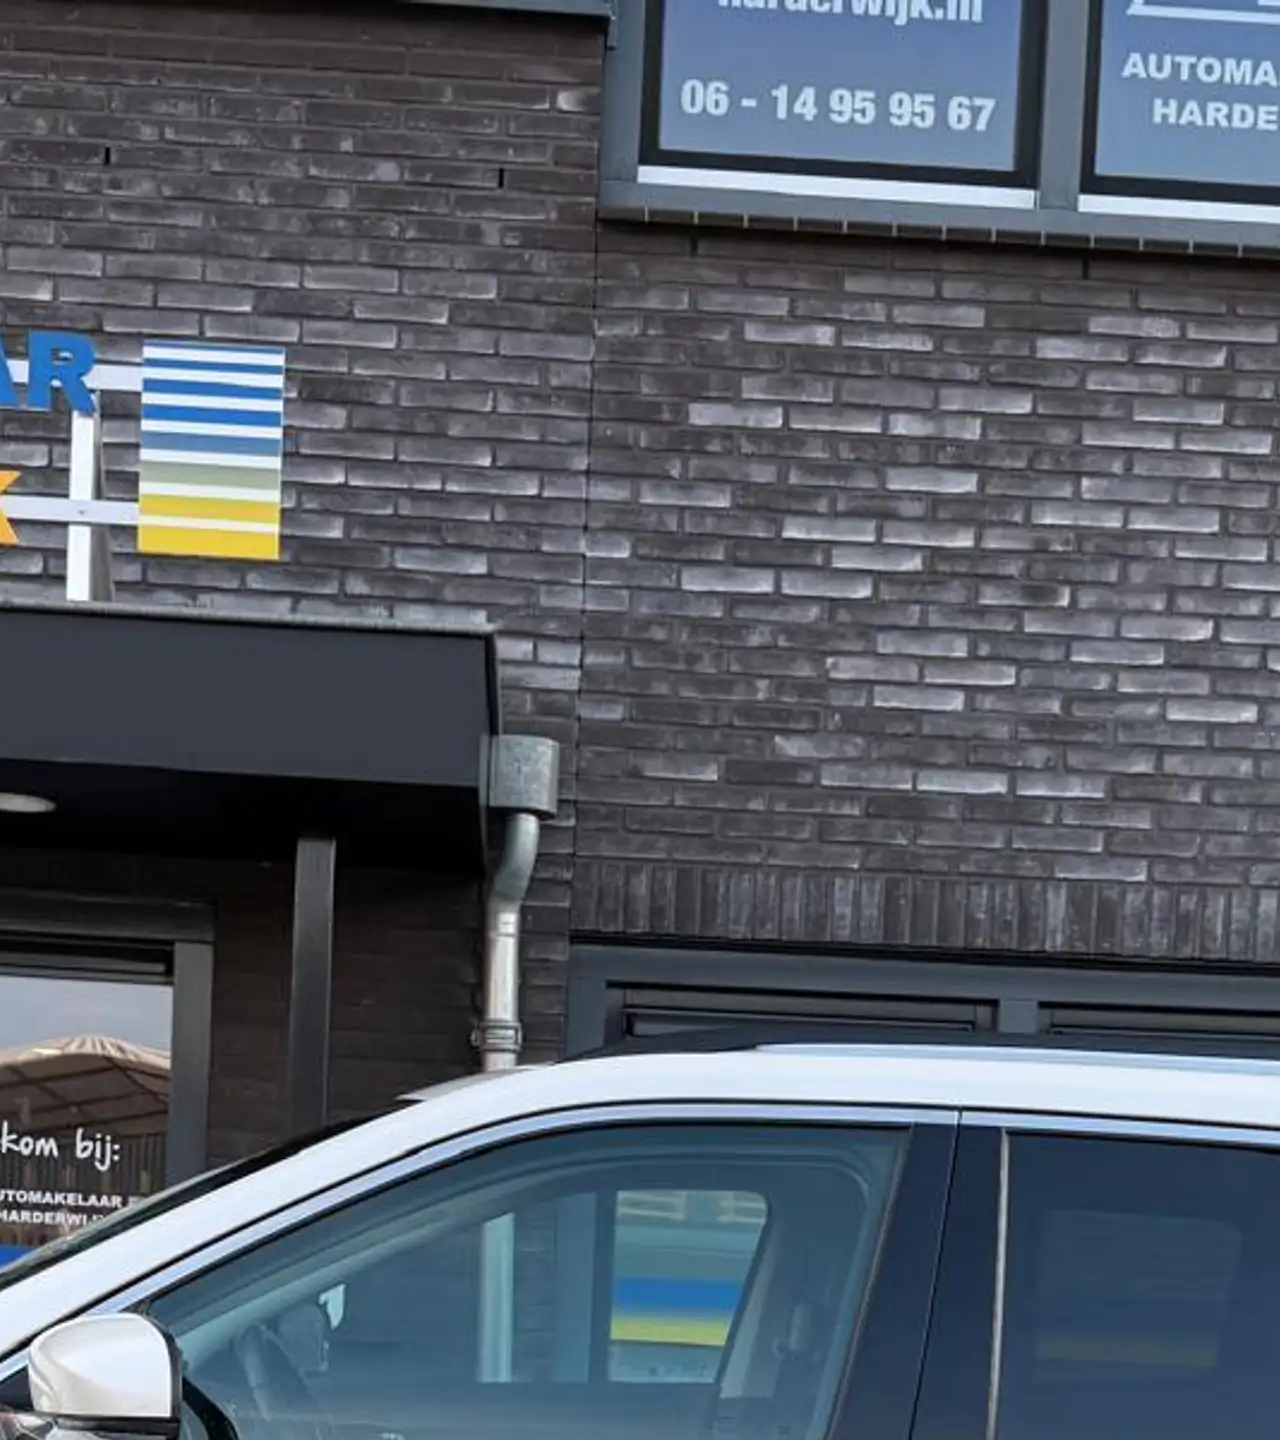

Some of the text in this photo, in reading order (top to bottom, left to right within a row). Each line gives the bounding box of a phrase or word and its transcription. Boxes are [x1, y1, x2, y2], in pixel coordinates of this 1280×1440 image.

[718, 0, 983, 25] wijk.nl
[680, 79, 729, 116] 06
[771, 84, 818, 122] 14
[828, 88, 876, 125] 95
[888, 91, 935, 128] 95
[947, 96, 997, 131] 67
[75, 1127, 121, 1172] bij:
